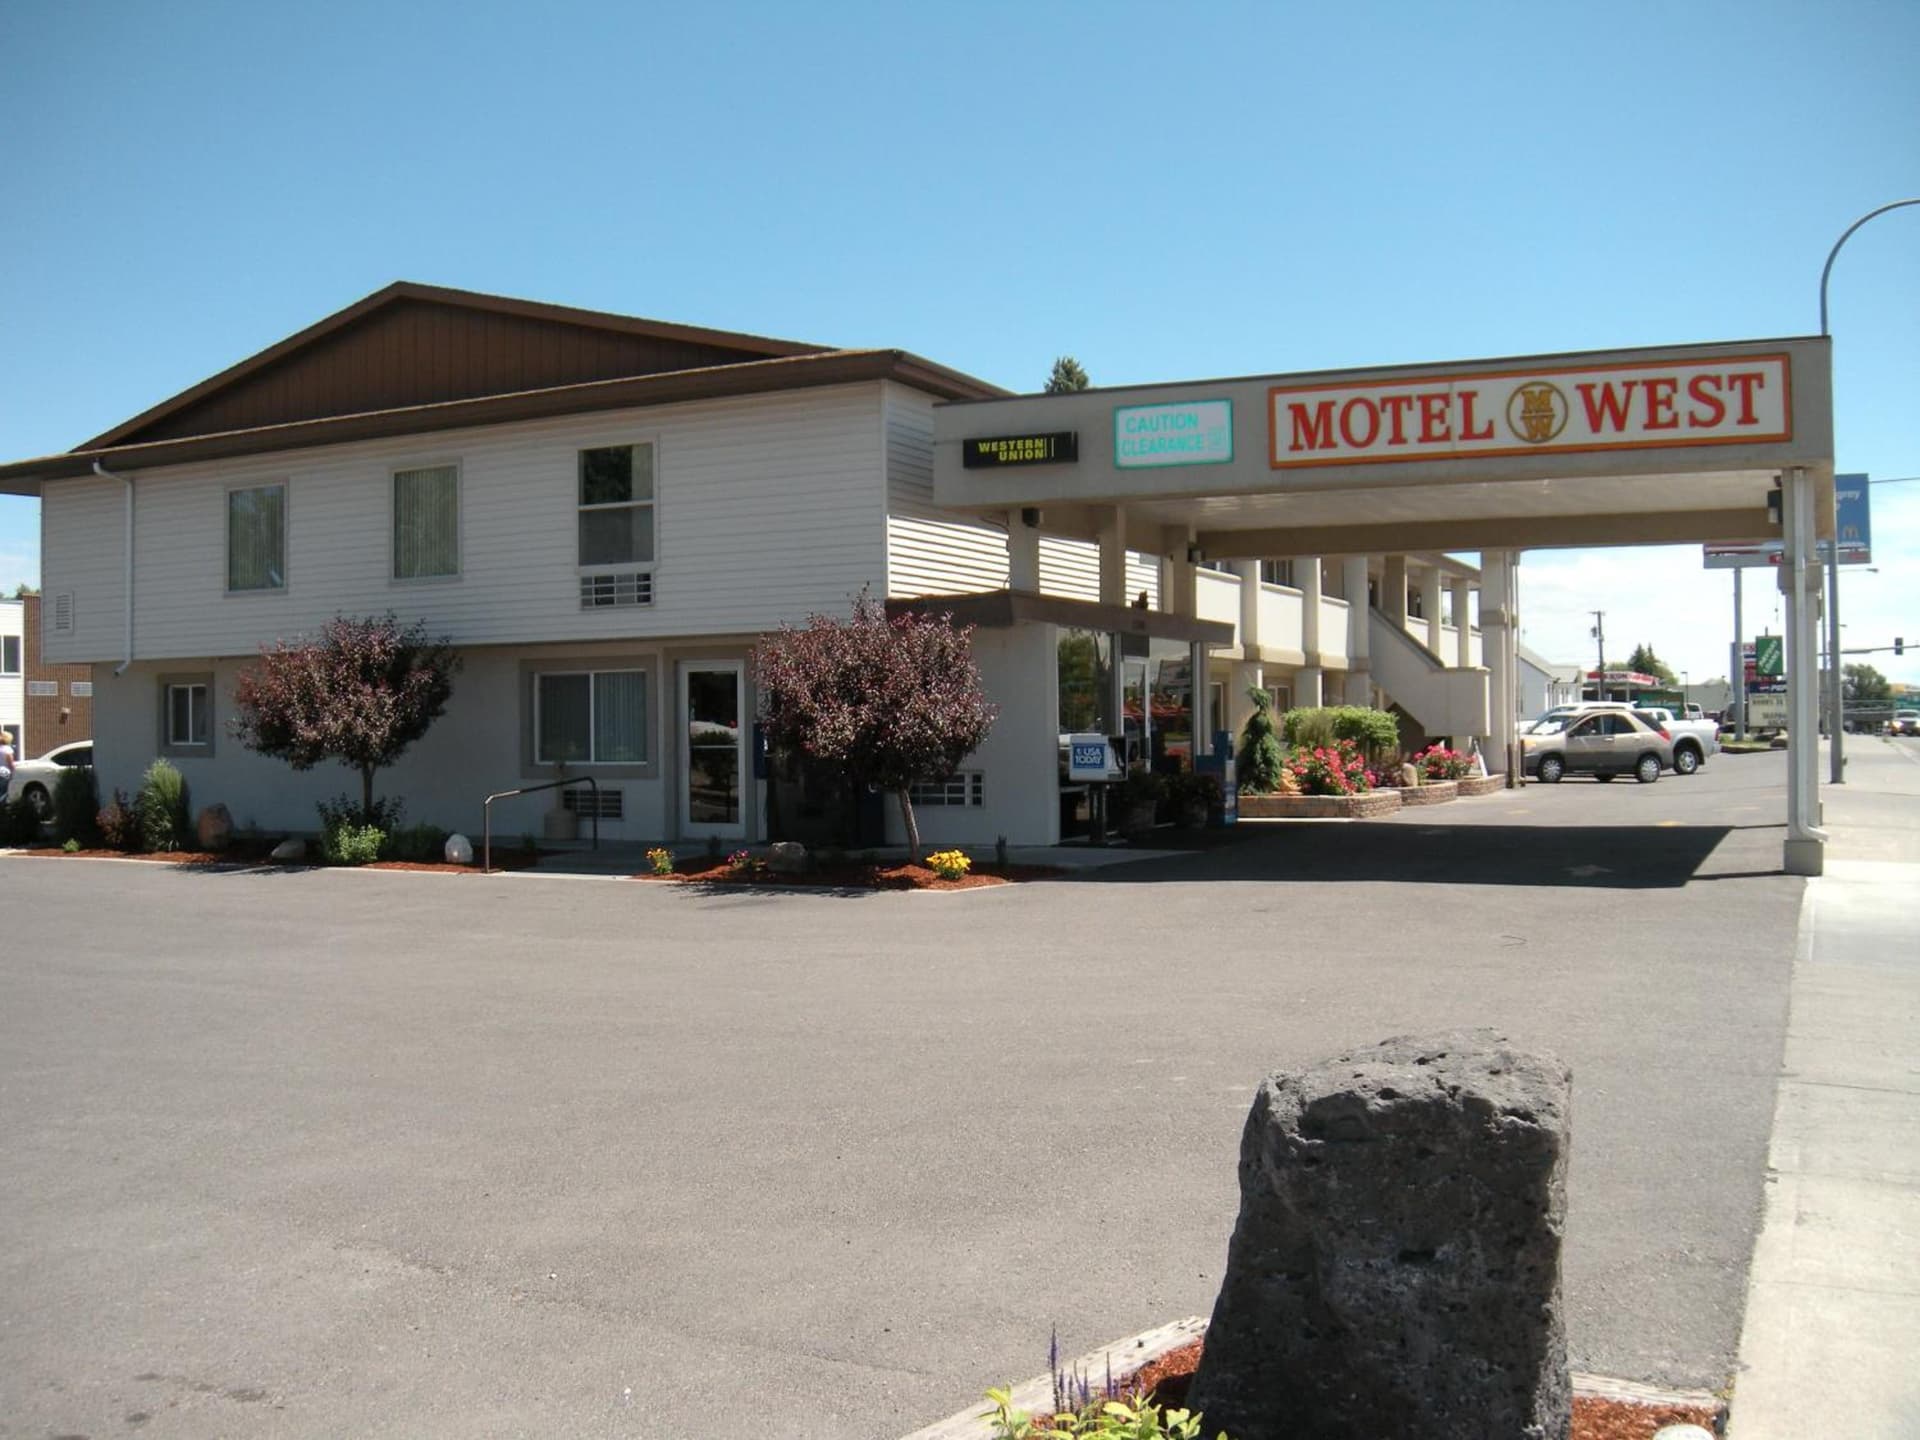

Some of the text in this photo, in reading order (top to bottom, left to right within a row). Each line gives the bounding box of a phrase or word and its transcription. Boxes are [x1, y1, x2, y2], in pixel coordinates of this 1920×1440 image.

[1288, 372, 1766, 452] MOTEL WEST
[1521, 389, 1555, 414] M
[1126, 413, 1199, 434] CAUTION
[1522, 415, 1554, 441] W
[978, 438, 1045, 453] WESTERN
[999, 449, 1045, 462] UNION
[1121, 433, 1202, 457] CLEARANCE
[1075, 755, 1102, 765] TODAY
[1083, 747, 1101, 757] USA
